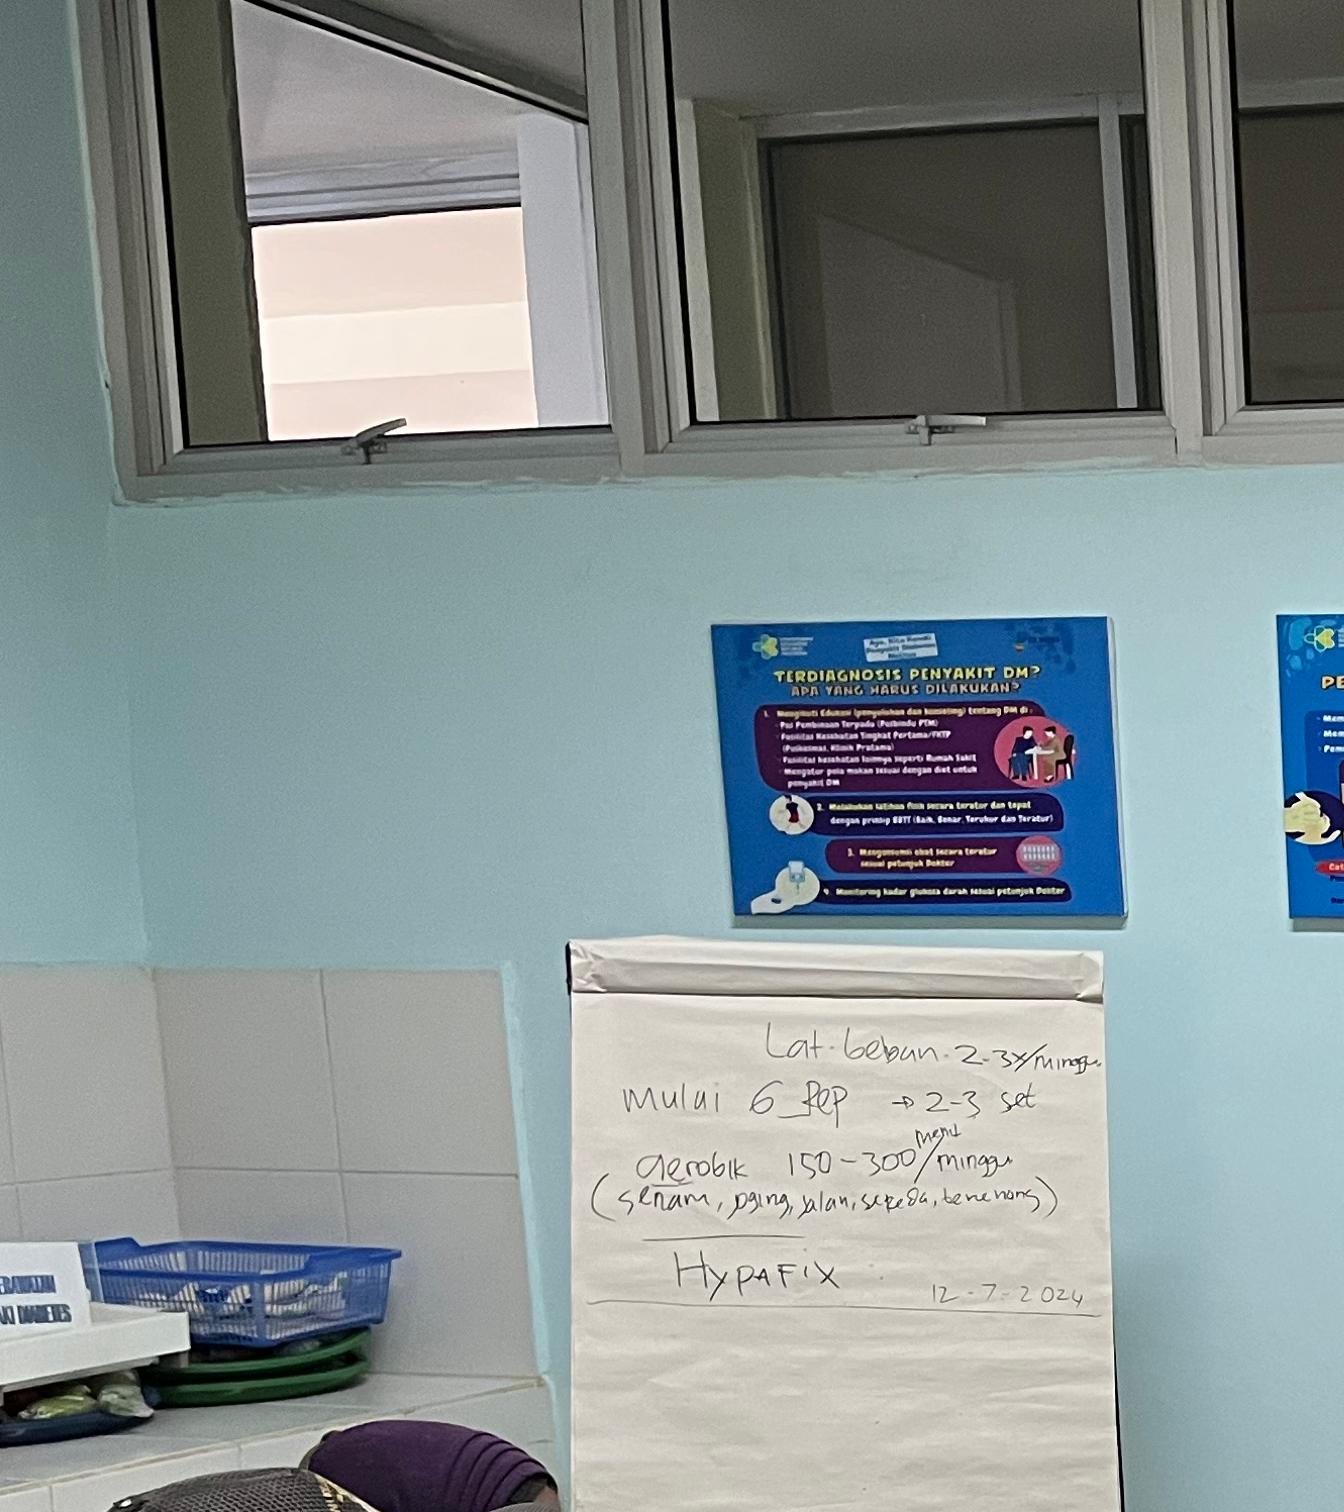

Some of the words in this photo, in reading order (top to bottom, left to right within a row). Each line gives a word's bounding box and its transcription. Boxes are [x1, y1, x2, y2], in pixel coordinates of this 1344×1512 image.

[773, 668, 902, 684] TERDIAGNOSIS
[909, 666, 996, 682] PENYAKIT
[1003, 665, 1041, 679] DM?
[791, 685, 819, 697] APA
[826, 684, 864, 697] YANG
[870, 683, 919, 695] HARUS
[925, 681, 1021, 695] DILAKUKAN?
[748, 1080, 784, 1117] 6
